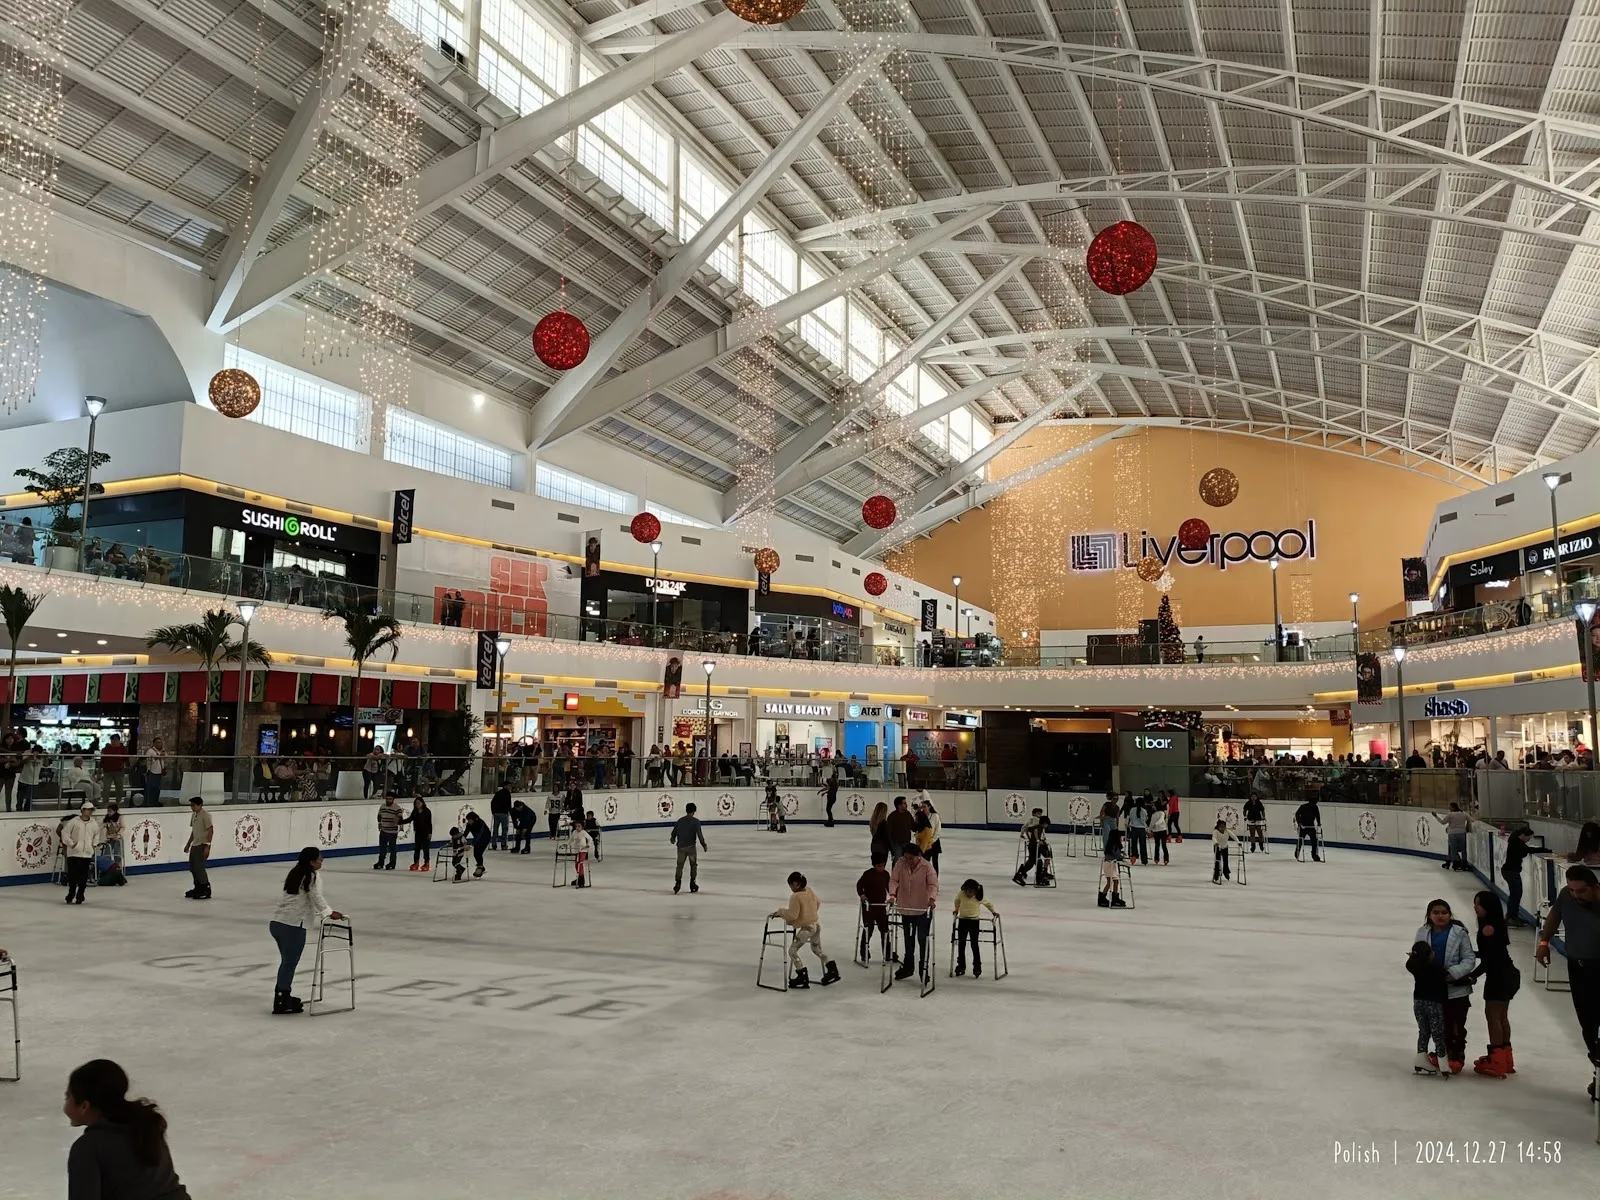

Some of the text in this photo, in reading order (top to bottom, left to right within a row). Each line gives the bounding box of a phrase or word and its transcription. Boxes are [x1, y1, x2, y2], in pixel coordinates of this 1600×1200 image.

[242, 509, 335, 541] SUSHI ROLL
[397, 492, 410, 541] telcel
[1470, 560, 1493, 576] Soley
[925, 600, 935, 631] telcel
[480, 633, 493, 687] telcel
[764, 703, 832, 716] SALLY BEAUTY
[861, 707, 881, 717] AT&T
[550, 799, 560, 809] 89
